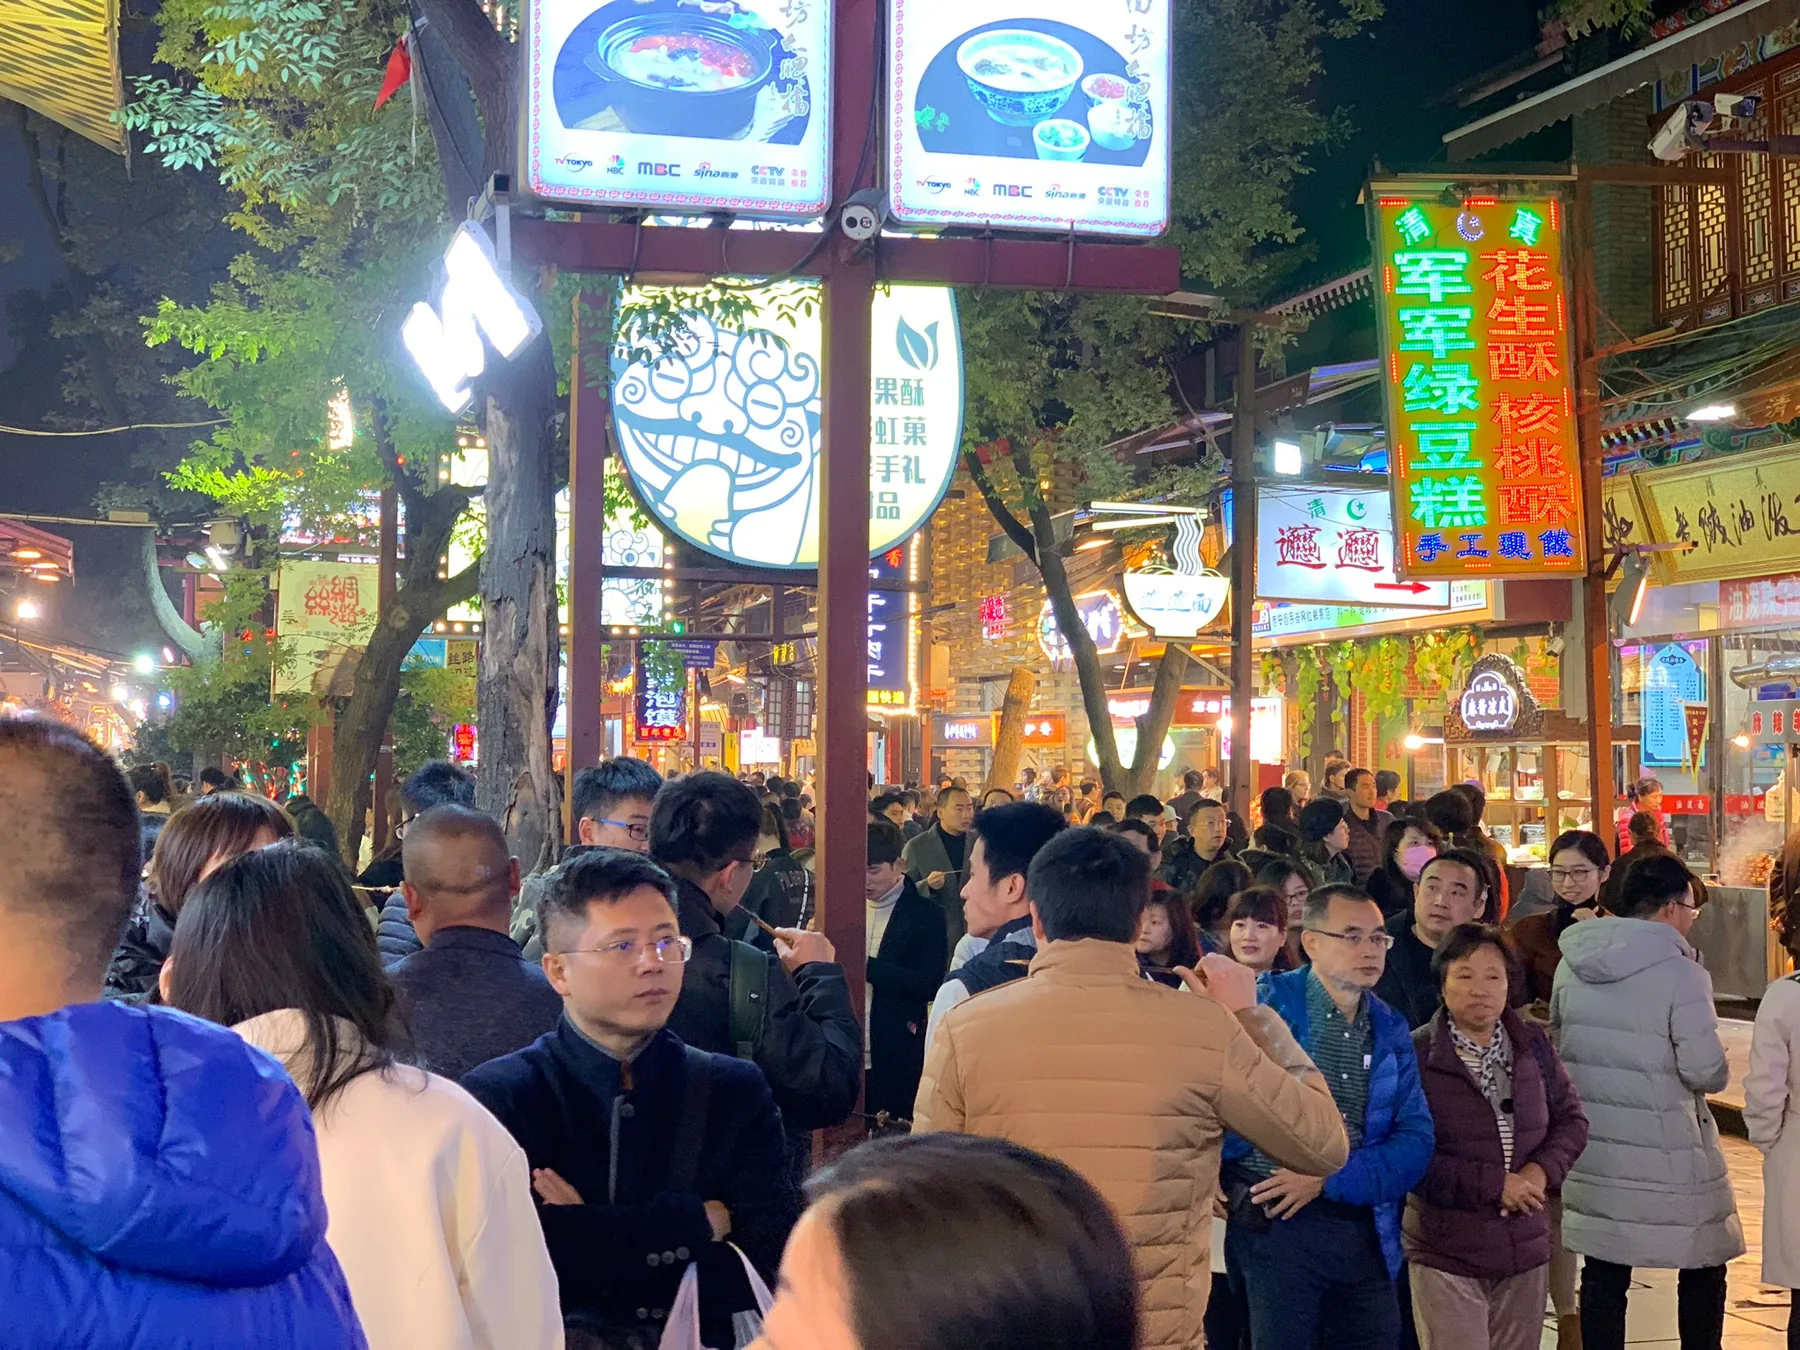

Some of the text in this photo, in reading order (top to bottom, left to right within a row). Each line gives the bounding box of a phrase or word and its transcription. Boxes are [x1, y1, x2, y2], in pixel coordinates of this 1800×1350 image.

[606, 166, 624, 175] NBC
[638, 161, 681, 177] MBC
[751, 165, 785, 176] CCTV
[993, 183, 1033, 198] MBC
[1098, 186, 1129, 197] CCTV
[1395, 207, 1542, 247] 清 真
[869, 377, 925, 407] 果酥
[1394, 250, 1487, 529] 军军绿豆糕
[869, 415, 928, 446] 虹菓
[869, 454, 926, 485] 手礼
[869, 490, 901, 520] 品
[1306, 497, 1326, 521] 清
[1415, 529, 1575, 560] 手工现做
